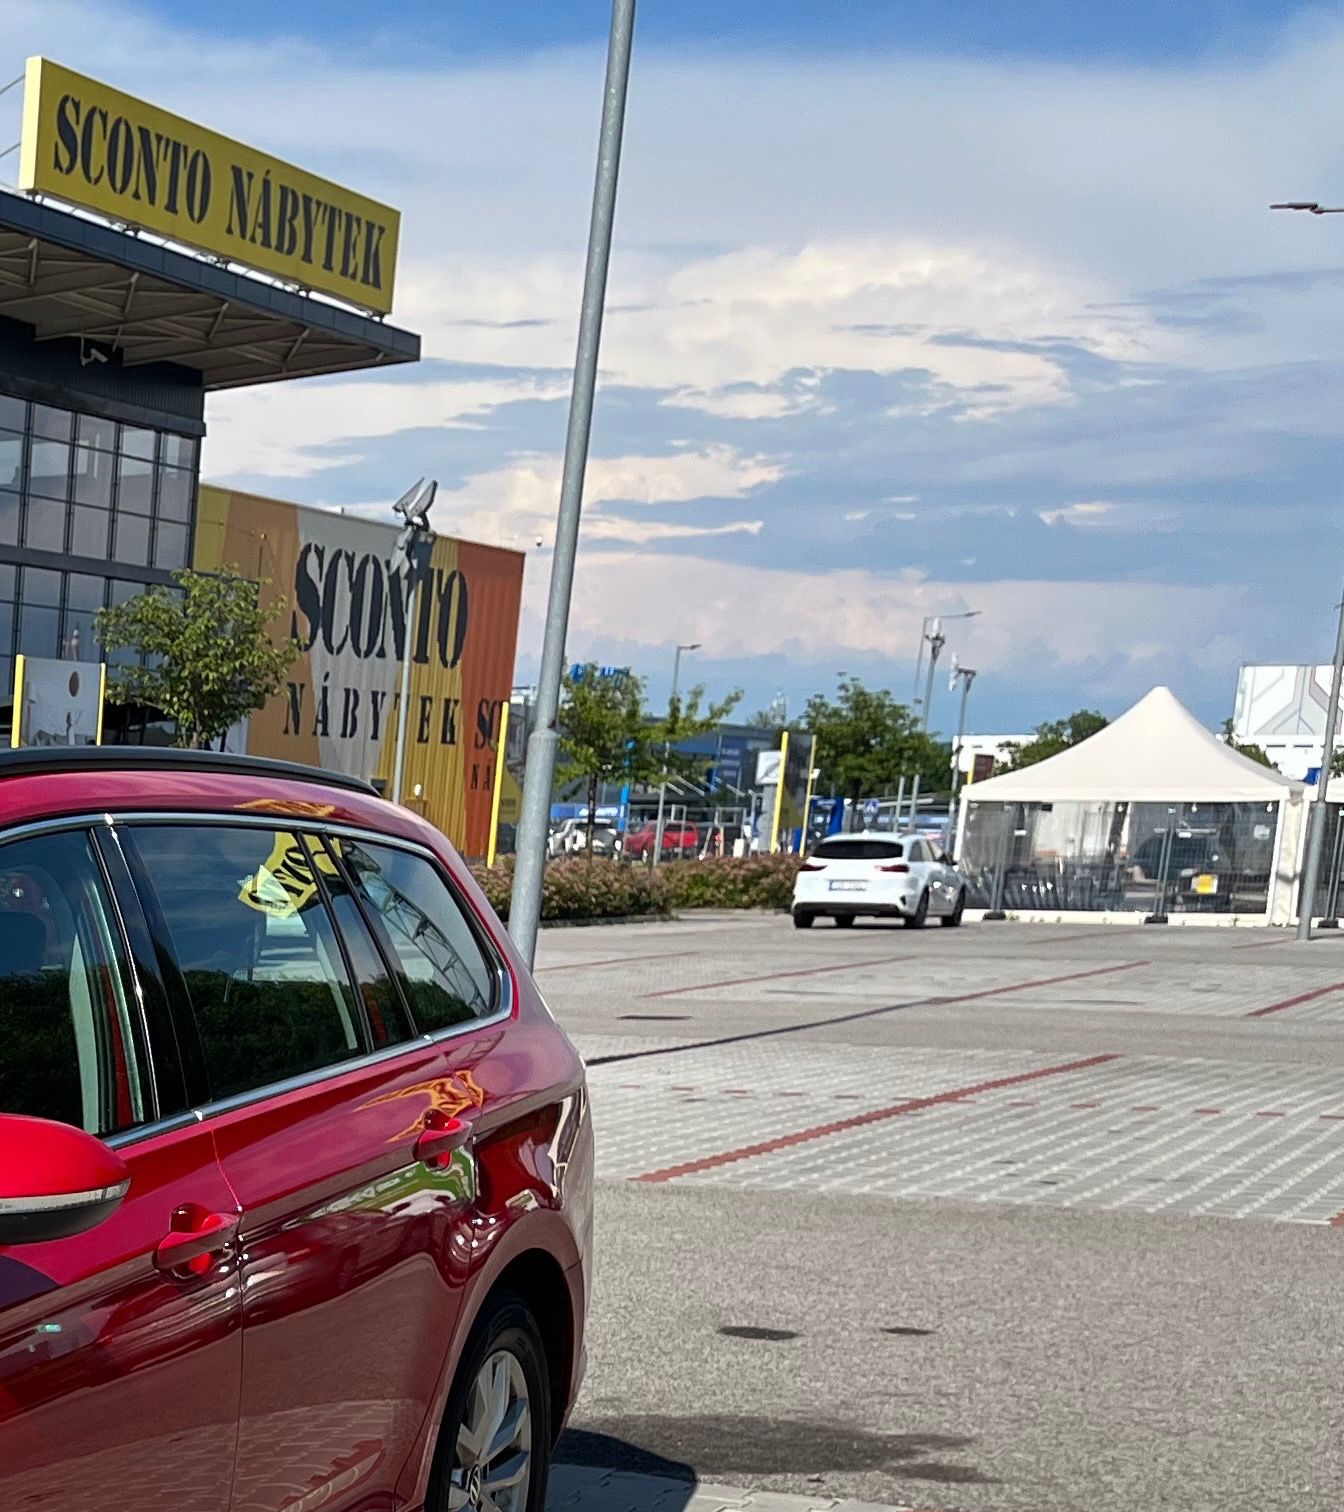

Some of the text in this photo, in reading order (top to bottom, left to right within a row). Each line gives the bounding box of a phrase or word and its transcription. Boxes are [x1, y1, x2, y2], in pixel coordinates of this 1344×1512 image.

[53, 94, 386, 289] SCONTO NÁBYTEK
[291, 542, 468, 668] SCONTO
[282, 671, 460, 745] NÁBYEK
